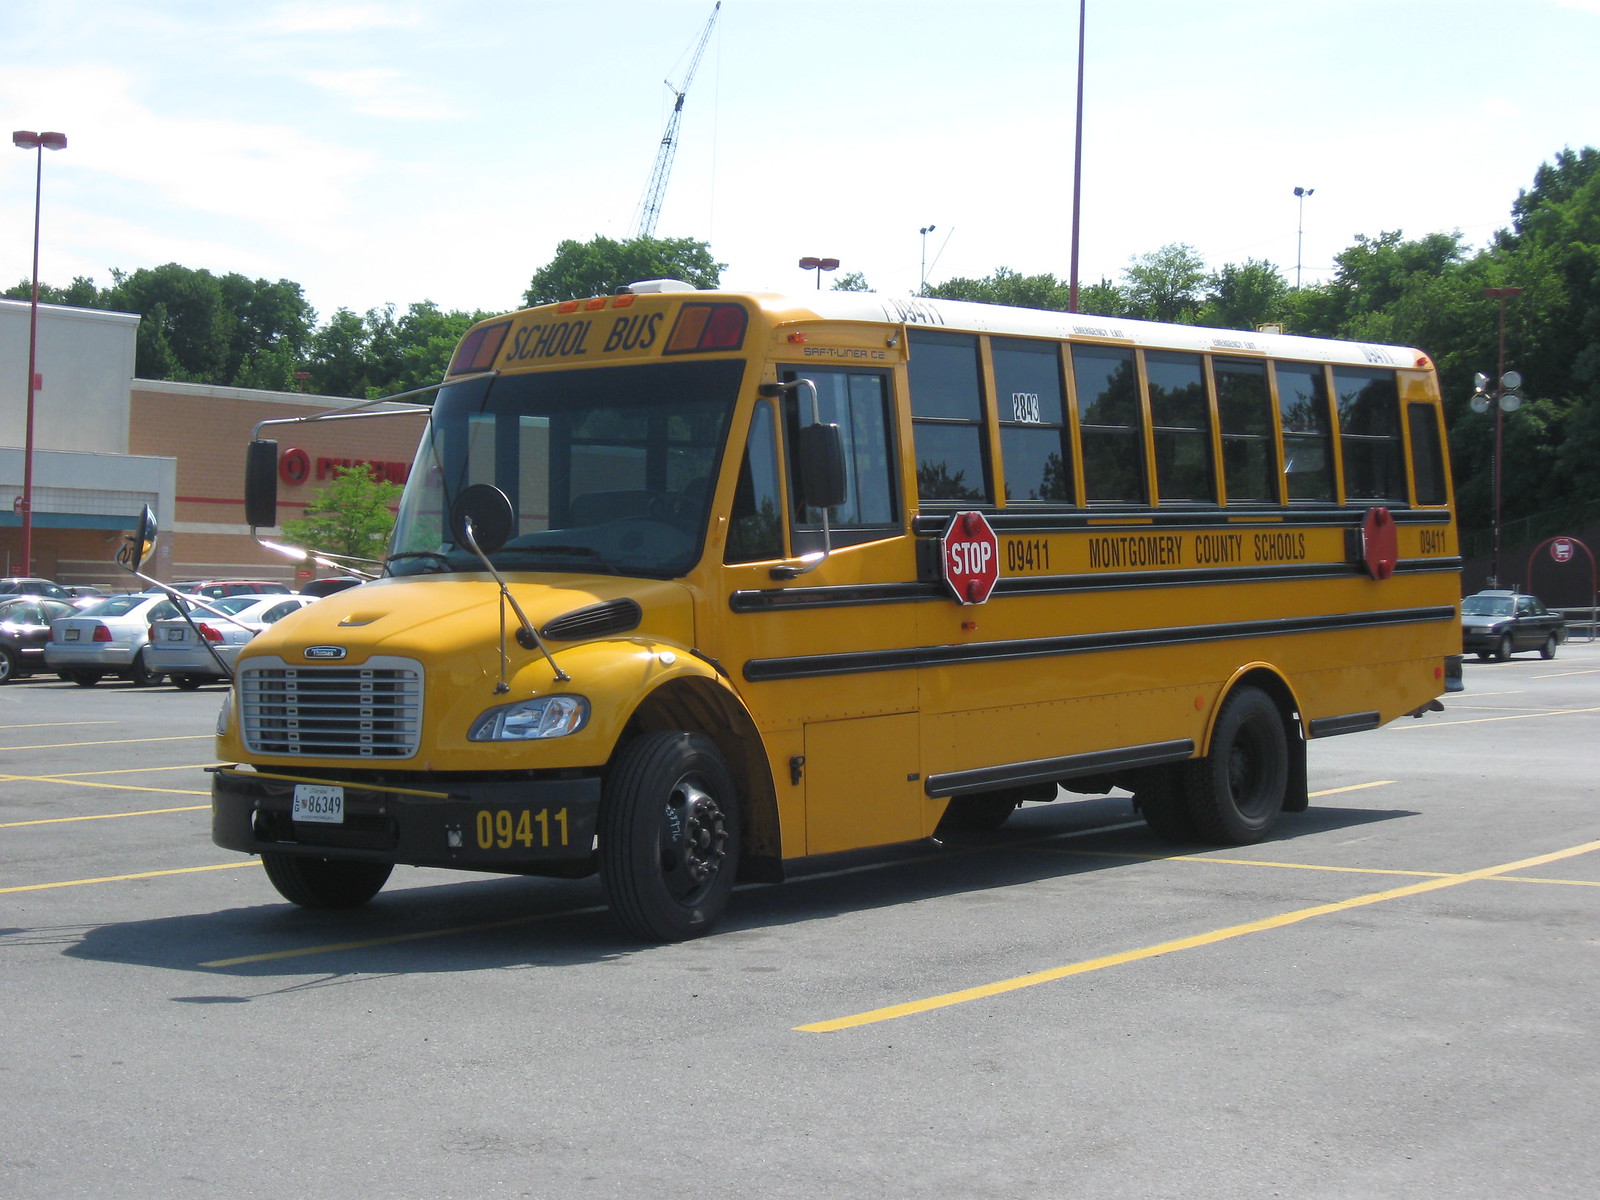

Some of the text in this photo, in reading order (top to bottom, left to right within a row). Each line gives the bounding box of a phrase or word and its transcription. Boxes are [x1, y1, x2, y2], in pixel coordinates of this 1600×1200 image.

[506, 312, 664, 361] SCHOOL BUS
[1072, 325, 1124, 338] EMERGENCY EXIT
[1211, 338, 1243, 349] EMERGENCY
[870, 350, 885, 359] C2
[1013, 393, 1039, 422] 2843
[1007, 539, 1049, 571] 09411
[1089, 532, 1305, 568] MONTGOMERY COUNTY SCHOOLS
[1420, 529, 1446, 553] 09411
[951, 541, 992, 575] STOP
[308, 795, 341, 814] 86349
[476, 807, 569, 850] 09411
